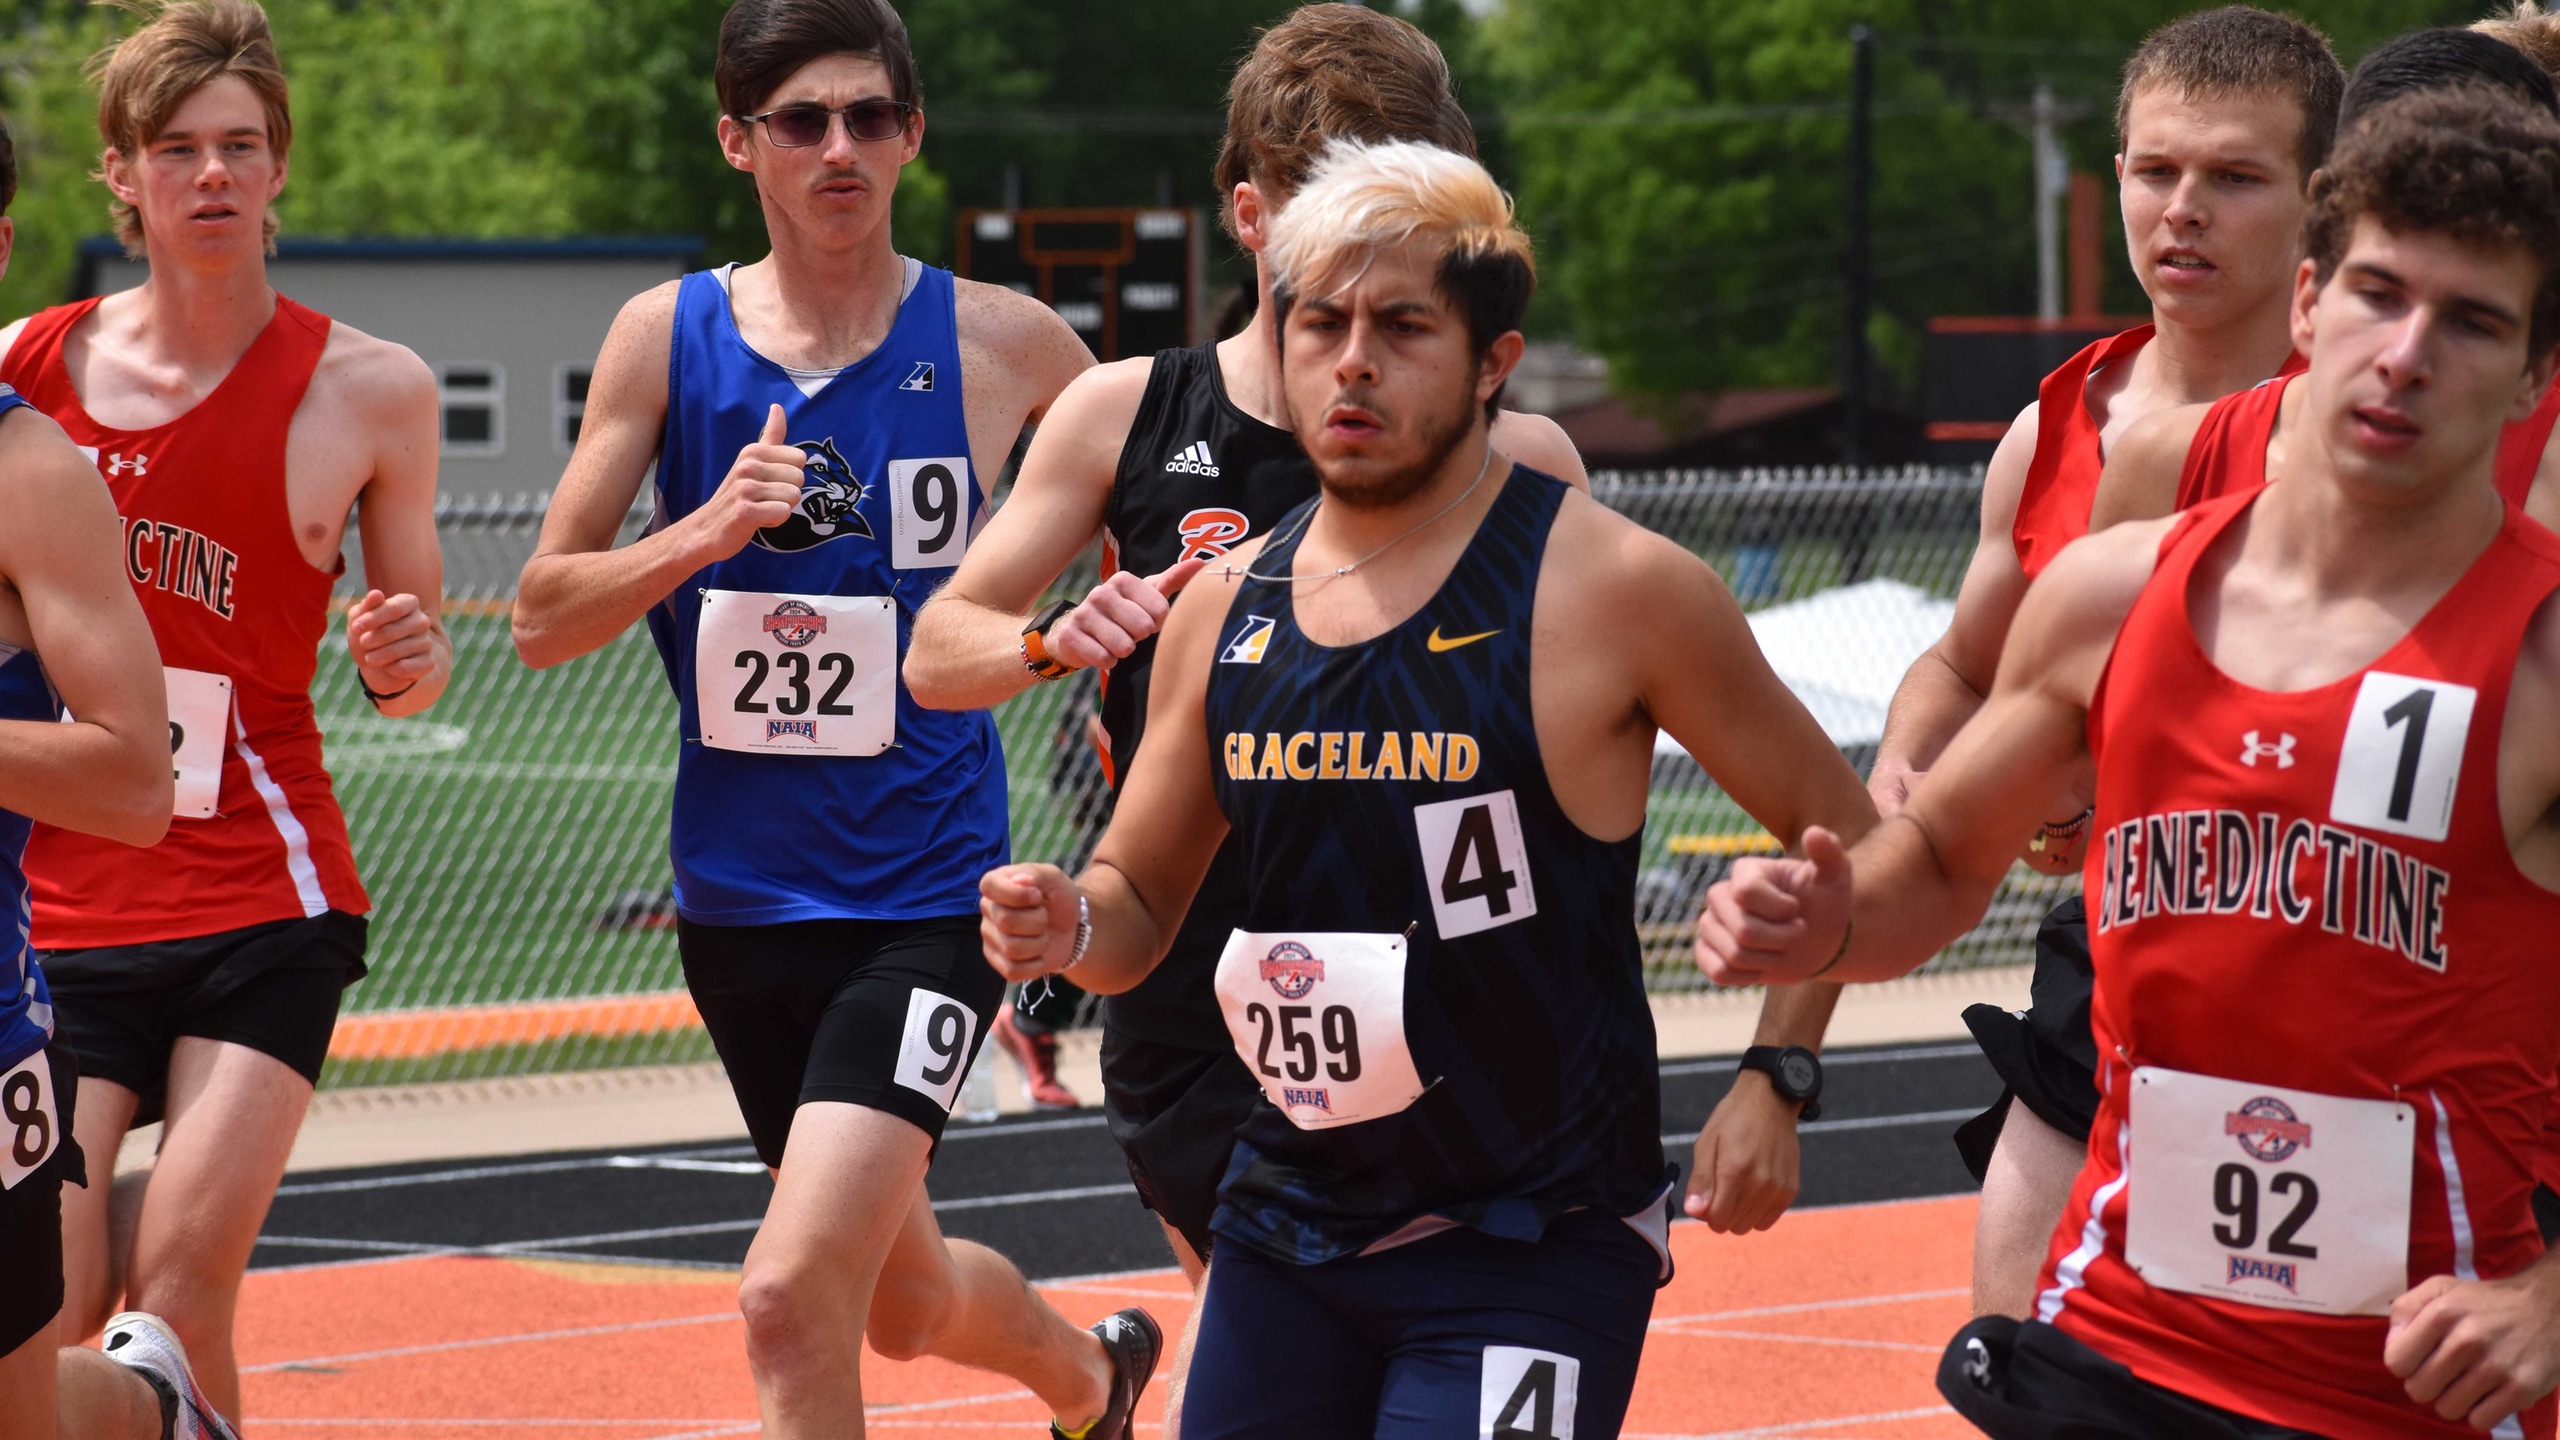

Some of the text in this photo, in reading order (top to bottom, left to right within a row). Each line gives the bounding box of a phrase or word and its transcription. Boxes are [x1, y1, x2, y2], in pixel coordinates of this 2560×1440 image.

[896, 465, 904, 536] midwesttiming.com
[912, 463, 958, 554] 9
[1165, 460, 1220, 477] adidas
[120, 516, 238, 621] CTINE
[763, 614, 827, 634] CHAMPIONSHIPS
[734, 650, 854, 716] 232
[768, 721, 815, 738] NAIA
[1224, 731, 1480, 782] GRACELAND
[2382, 688, 2436, 823] 1
[1441, 804, 1518, 918] 4
[2098, 809, 2450, 973] BENEDICTINE
[921, 1003, 966, 1086] 9
[1246, 1002, 1361, 1082] 259
[2, 1070, 50, 1167] 8
[1284, 1088, 1329, 1110] NAIA
[2213, 1163, 2319, 1259] 92
[2229, 1259, 2294, 1288] NAIA
[1492, 1358, 1560, 1440] 4
